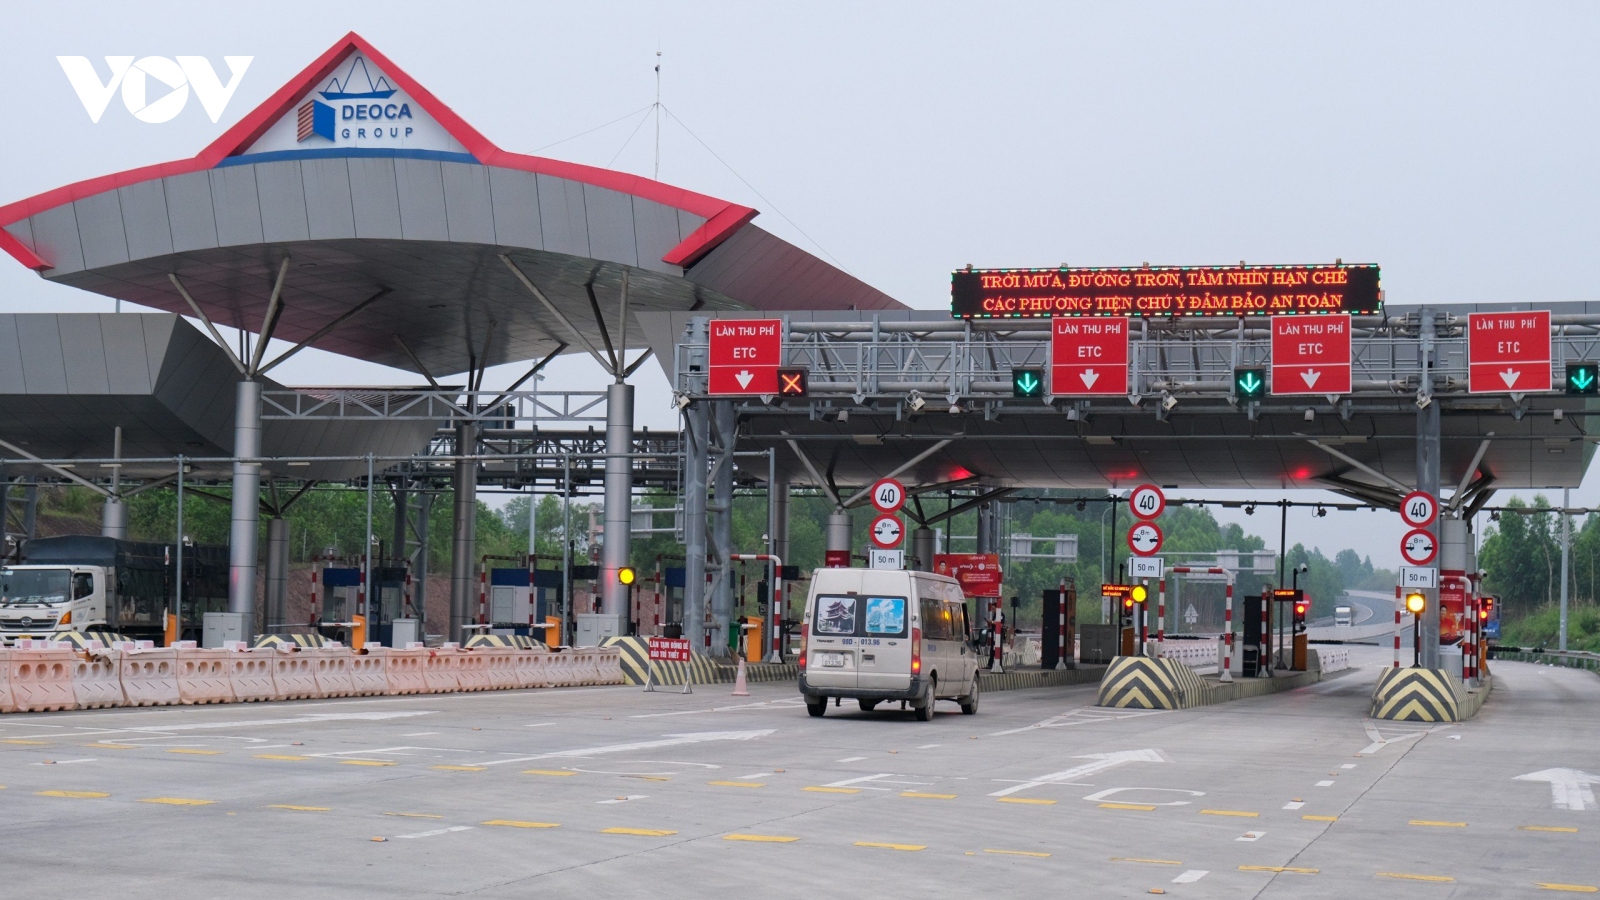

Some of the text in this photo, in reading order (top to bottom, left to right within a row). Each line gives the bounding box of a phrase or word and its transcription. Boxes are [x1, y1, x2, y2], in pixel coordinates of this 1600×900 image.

[342, 103, 413, 121] DEOCA
[341, 126, 414, 139] GROUP
[981, 273, 1021, 288] TRỜI
[1024, 273, 1065, 290] MƯA,
[1069, 272, 1131, 287] ĐƯỜNG
[1135, 272, 1183, 288] TRƠN,
[1227, 270, 1268, 285] NHÌN
[1272, 271, 1307, 287] HẠN
[1312, 268, 1347, 284] CHẾ
[983, 291, 1343, 312] CÁC PHƯƠNG TIỆN CHÚ Ý ĐẢM BẢO AN TOÀN
[716, 324, 774, 336] LÀN THU PHÍ
[1058, 322, 1121, 335] LÀN THU PHÍ
[1279, 321, 1343, 335] LÀN THU PHÍ
[1476, 317, 1536, 330] LÀN THU PHÍ
[733, 347, 757, 359] ETC
[1077, 346, 1102, 358] ETC
[1298, 343, 1323, 355] ETC
[1497, 342, 1520, 354] ETC
[880, 488, 895, 504] 40
[1139, 495, 1155, 510] 40
[1411, 502, 1427, 518] 40
[1137, 563, 1146, 571] 50
[1409, 573, 1418, 581] 50
